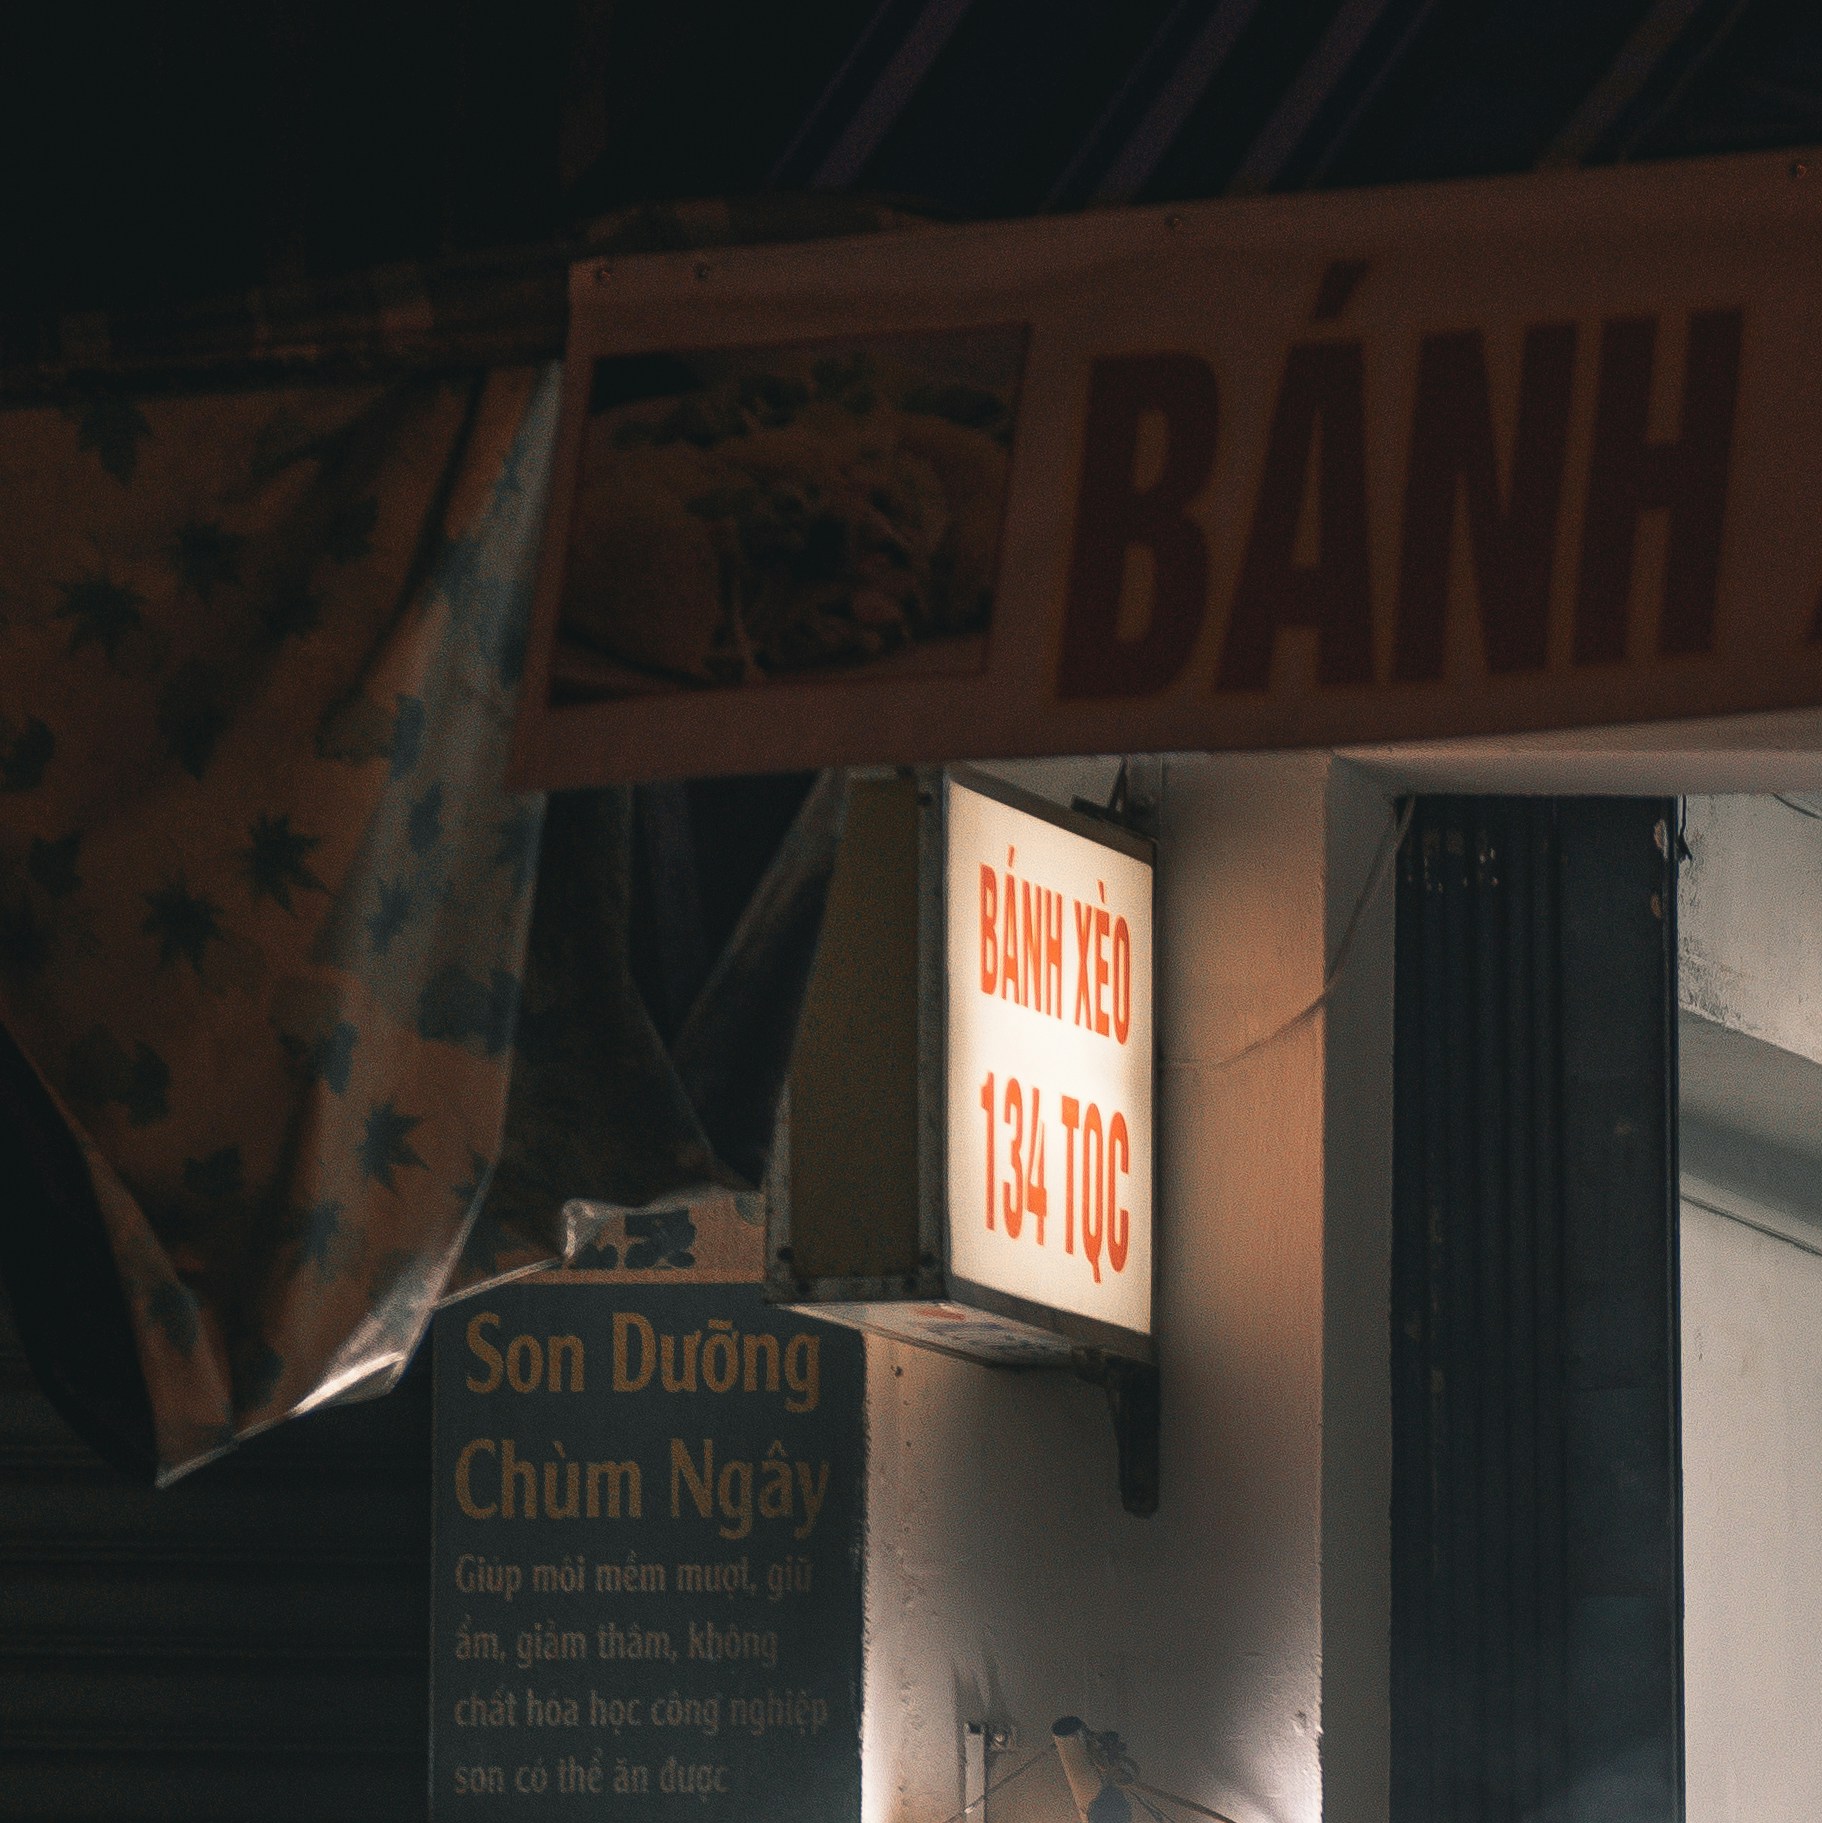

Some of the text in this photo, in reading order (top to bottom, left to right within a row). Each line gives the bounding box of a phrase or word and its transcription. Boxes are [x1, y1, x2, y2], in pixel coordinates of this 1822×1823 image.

[1056, 258, 1745, 701] BÁNH
[979, 846, 1131, 1046] BÁNH XÈO
[979, 1071, 1131, 1285] 134 TQC
[465, 1313, 821, 1412] Son Dưỡng
[455, 1438, 829, 1540] Chùm Ngây
[533, 1555, 586, 1593] môi
[689, 1621, 778, 1669] không
[590, 1689, 641, 1735] học
[651, 1690, 721, 1737] công
[730, 1689, 828, 1737] nghiệp
[454, 1766, 505, 1795] son
[515, 1757, 548, 1795] có
[613, 1757, 649, 1795] ăn
